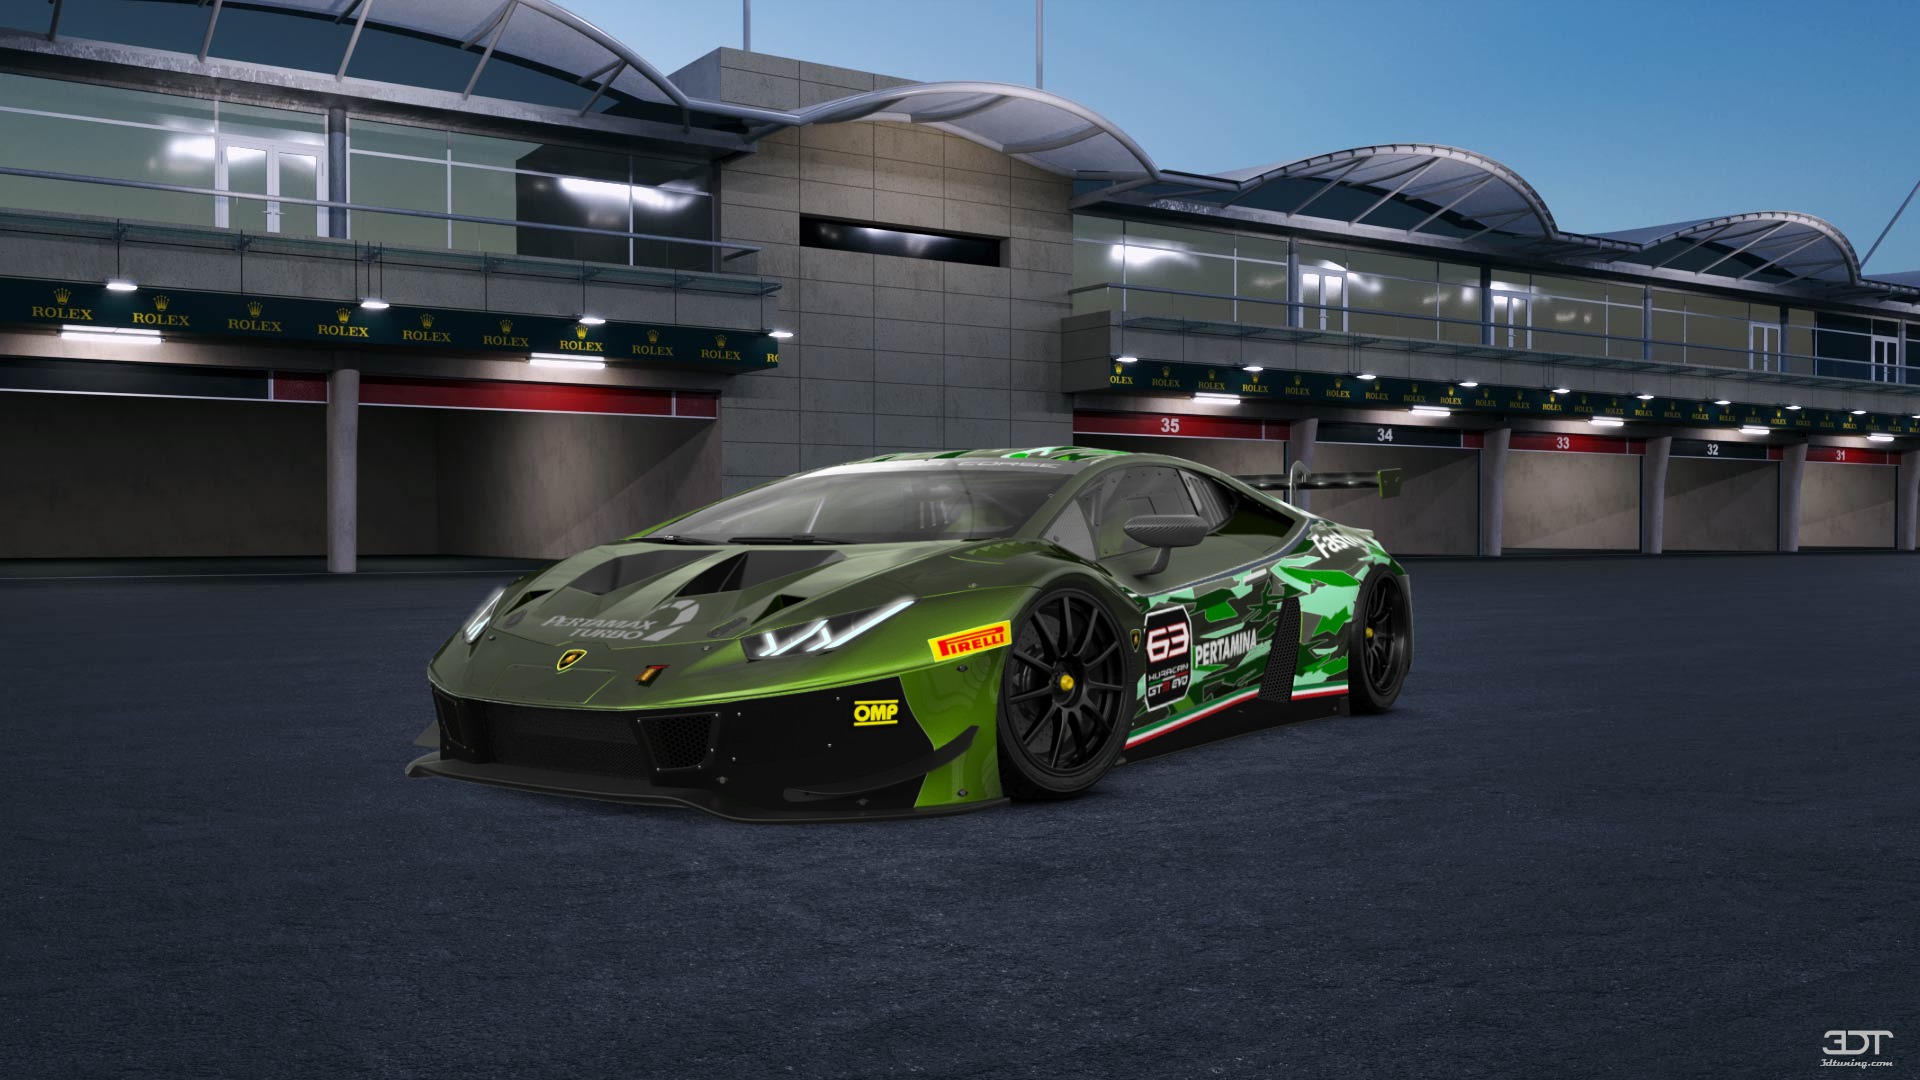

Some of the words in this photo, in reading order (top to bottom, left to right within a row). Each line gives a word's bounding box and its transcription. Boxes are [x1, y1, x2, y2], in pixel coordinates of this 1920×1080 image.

[32, 306, 93, 321] ROLEX
[133, 312, 190, 327] ROLEX
[228, 318, 282, 332] ROLEX
[317, 324, 370, 338] ROLEX
[403, 330, 450, 342] ROLEX
[483, 335, 529, 347] ROLEX
[560, 340, 603, 352] ROLEX
[632, 345, 673, 356] ROLEX
[701, 349, 741, 360] ROLEX
[1110, 375, 1134, 385] OLEX
[1152, 378, 1180, 388] ROLEX
[1198, 381, 1225, 391] ROLEX
[1242, 383, 1268, 393] ROLEX
[1285, 387, 1310, 396] ROLEX
[1326, 389, 1350, 398] ROLEX
[1365, 391, 1389, 400] ROLEX
[1403, 394, 1426, 403] ROLEX
[1440, 396, 1462, 405] ROLEX
[1475, 399, 1496, 407] ROLEX
[1509, 401, 1529, 409] ROLEX
[1542, 403, 1562, 411] ROLEX
[1161, 418, 1180, 433] 35
[1377, 428, 1393, 442] 34
[1556, 437, 1570, 449] 33
[1707, 444, 1719, 456] 32
[1836, 450, 1846, 461] 31
[541, 615, 658, 630] PERTAMAX
[569, 627, 643, 639] TURBO
[937, 625, 1005, 656] PIRELLI
[1146, 622, 1190, 663] 63
[1195, 628, 1257, 668] PERTAMINA
[1148, 663, 1189, 681] HURACAN
[1171, 675, 1188, 689] EVO
[854, 704, 899, 722] OMP
